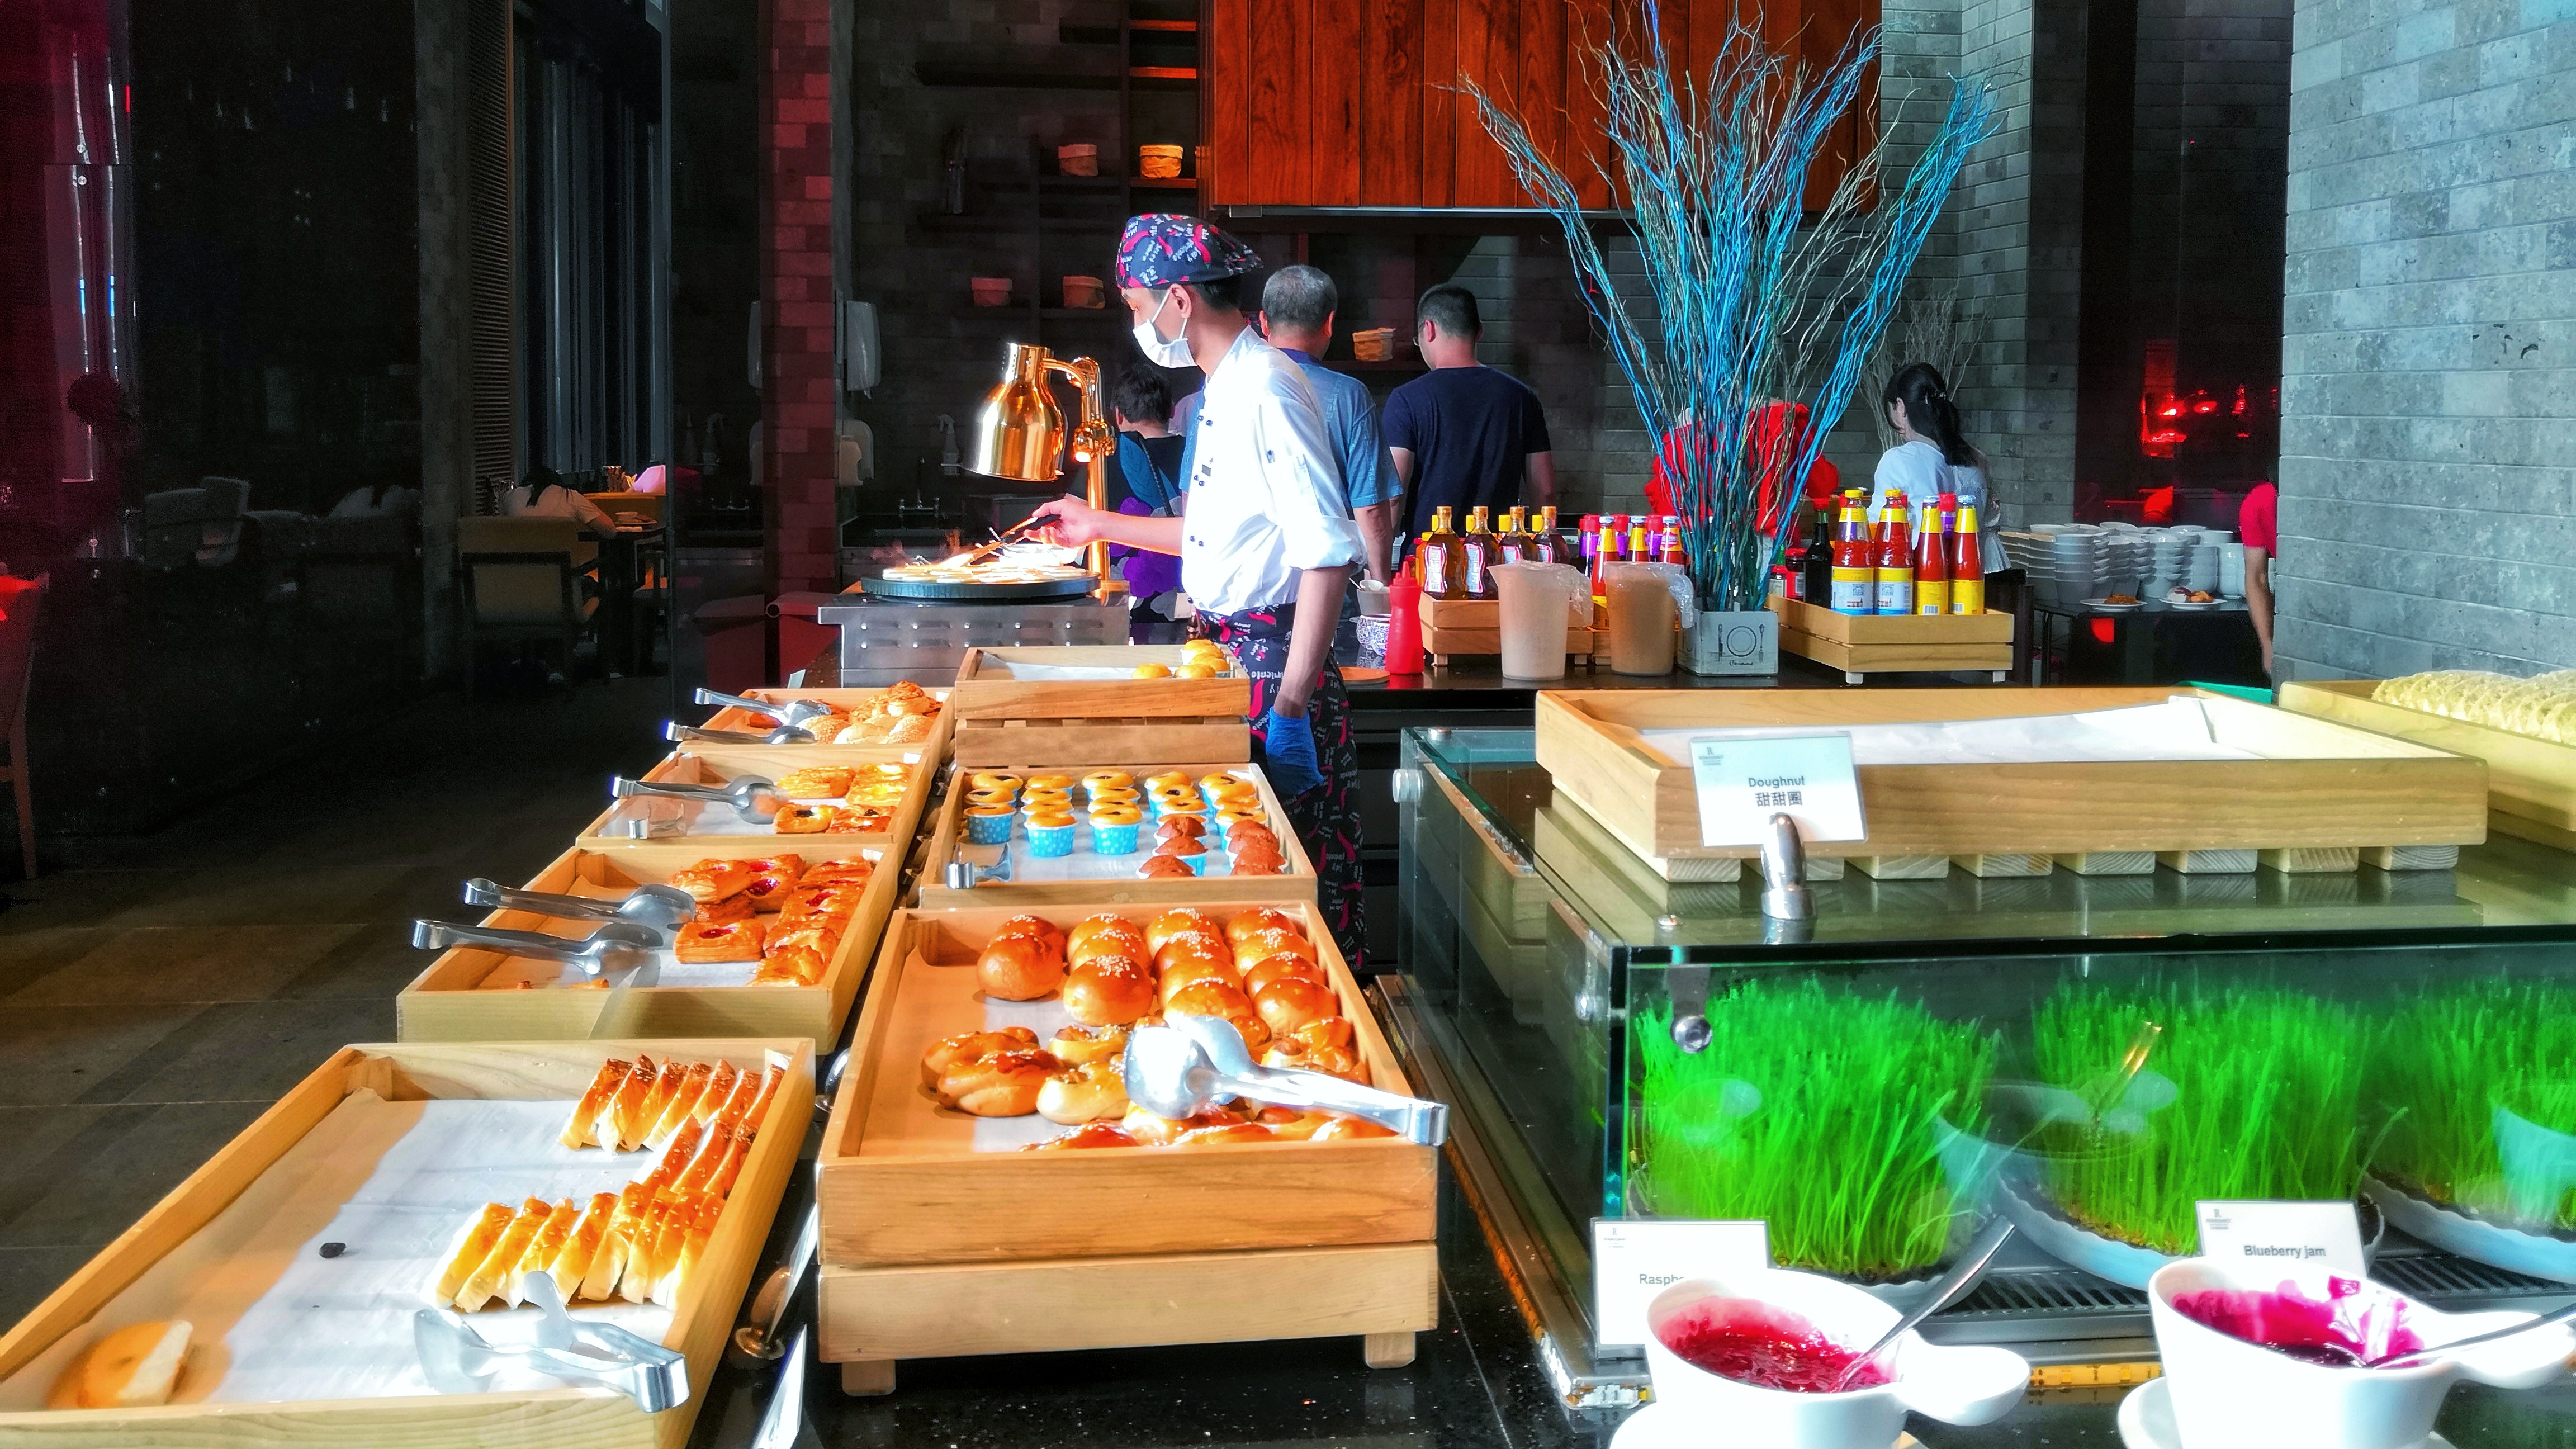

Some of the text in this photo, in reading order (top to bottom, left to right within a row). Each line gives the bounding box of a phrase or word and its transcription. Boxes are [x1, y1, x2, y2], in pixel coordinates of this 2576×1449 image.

[1748, 775, 1805, 789] Doughnut
[1755, 791, 1803, 807] 甜甜圈
[2243, 1245, 2326, 1259] Blueberry jam
